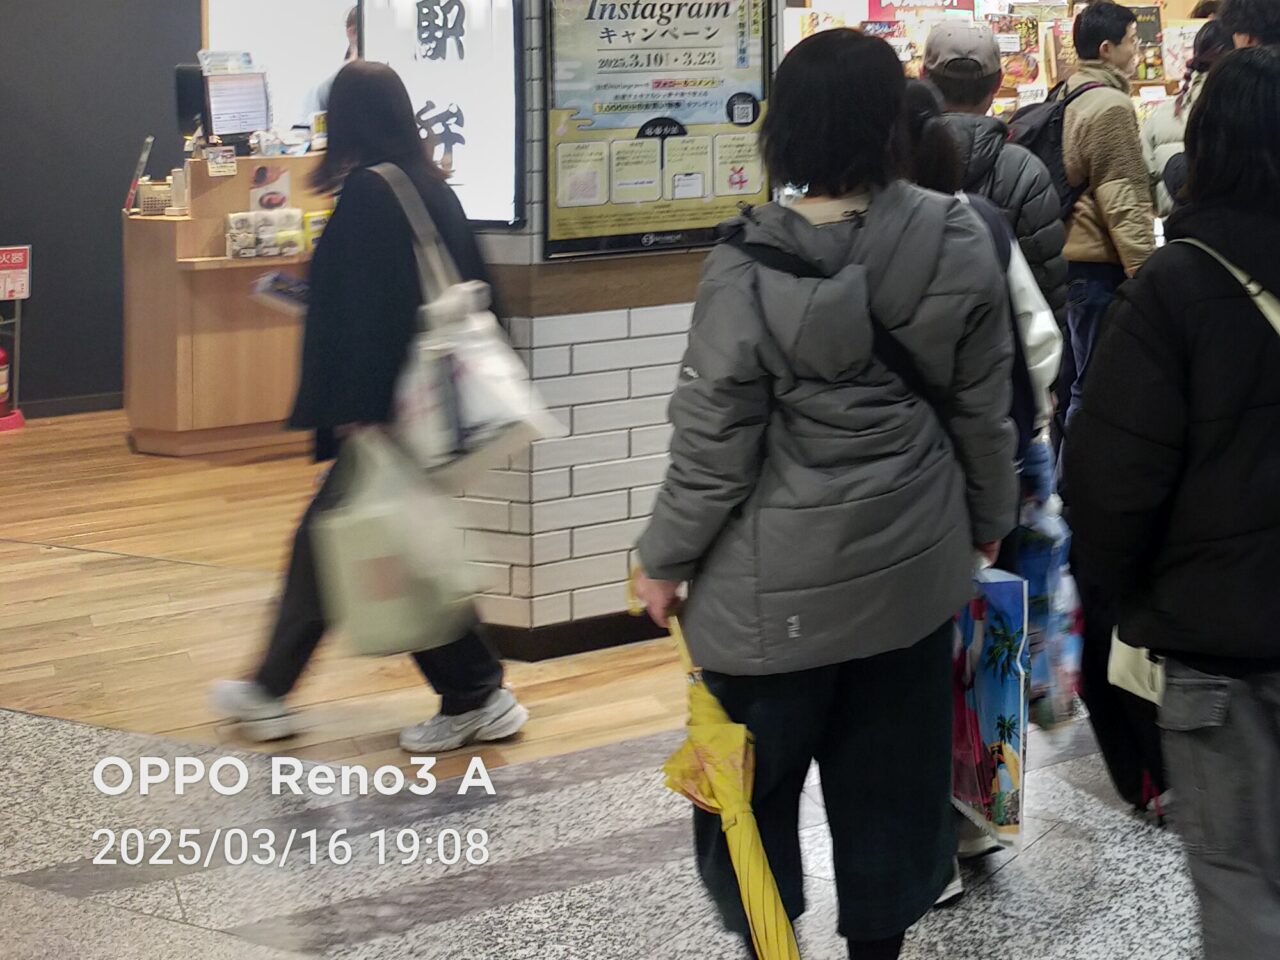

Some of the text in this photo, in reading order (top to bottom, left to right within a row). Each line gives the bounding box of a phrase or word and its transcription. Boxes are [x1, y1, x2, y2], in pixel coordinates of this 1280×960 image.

[600, 27, 720, 44] キャンペーン
[0, 252, 24, 265] 火器
